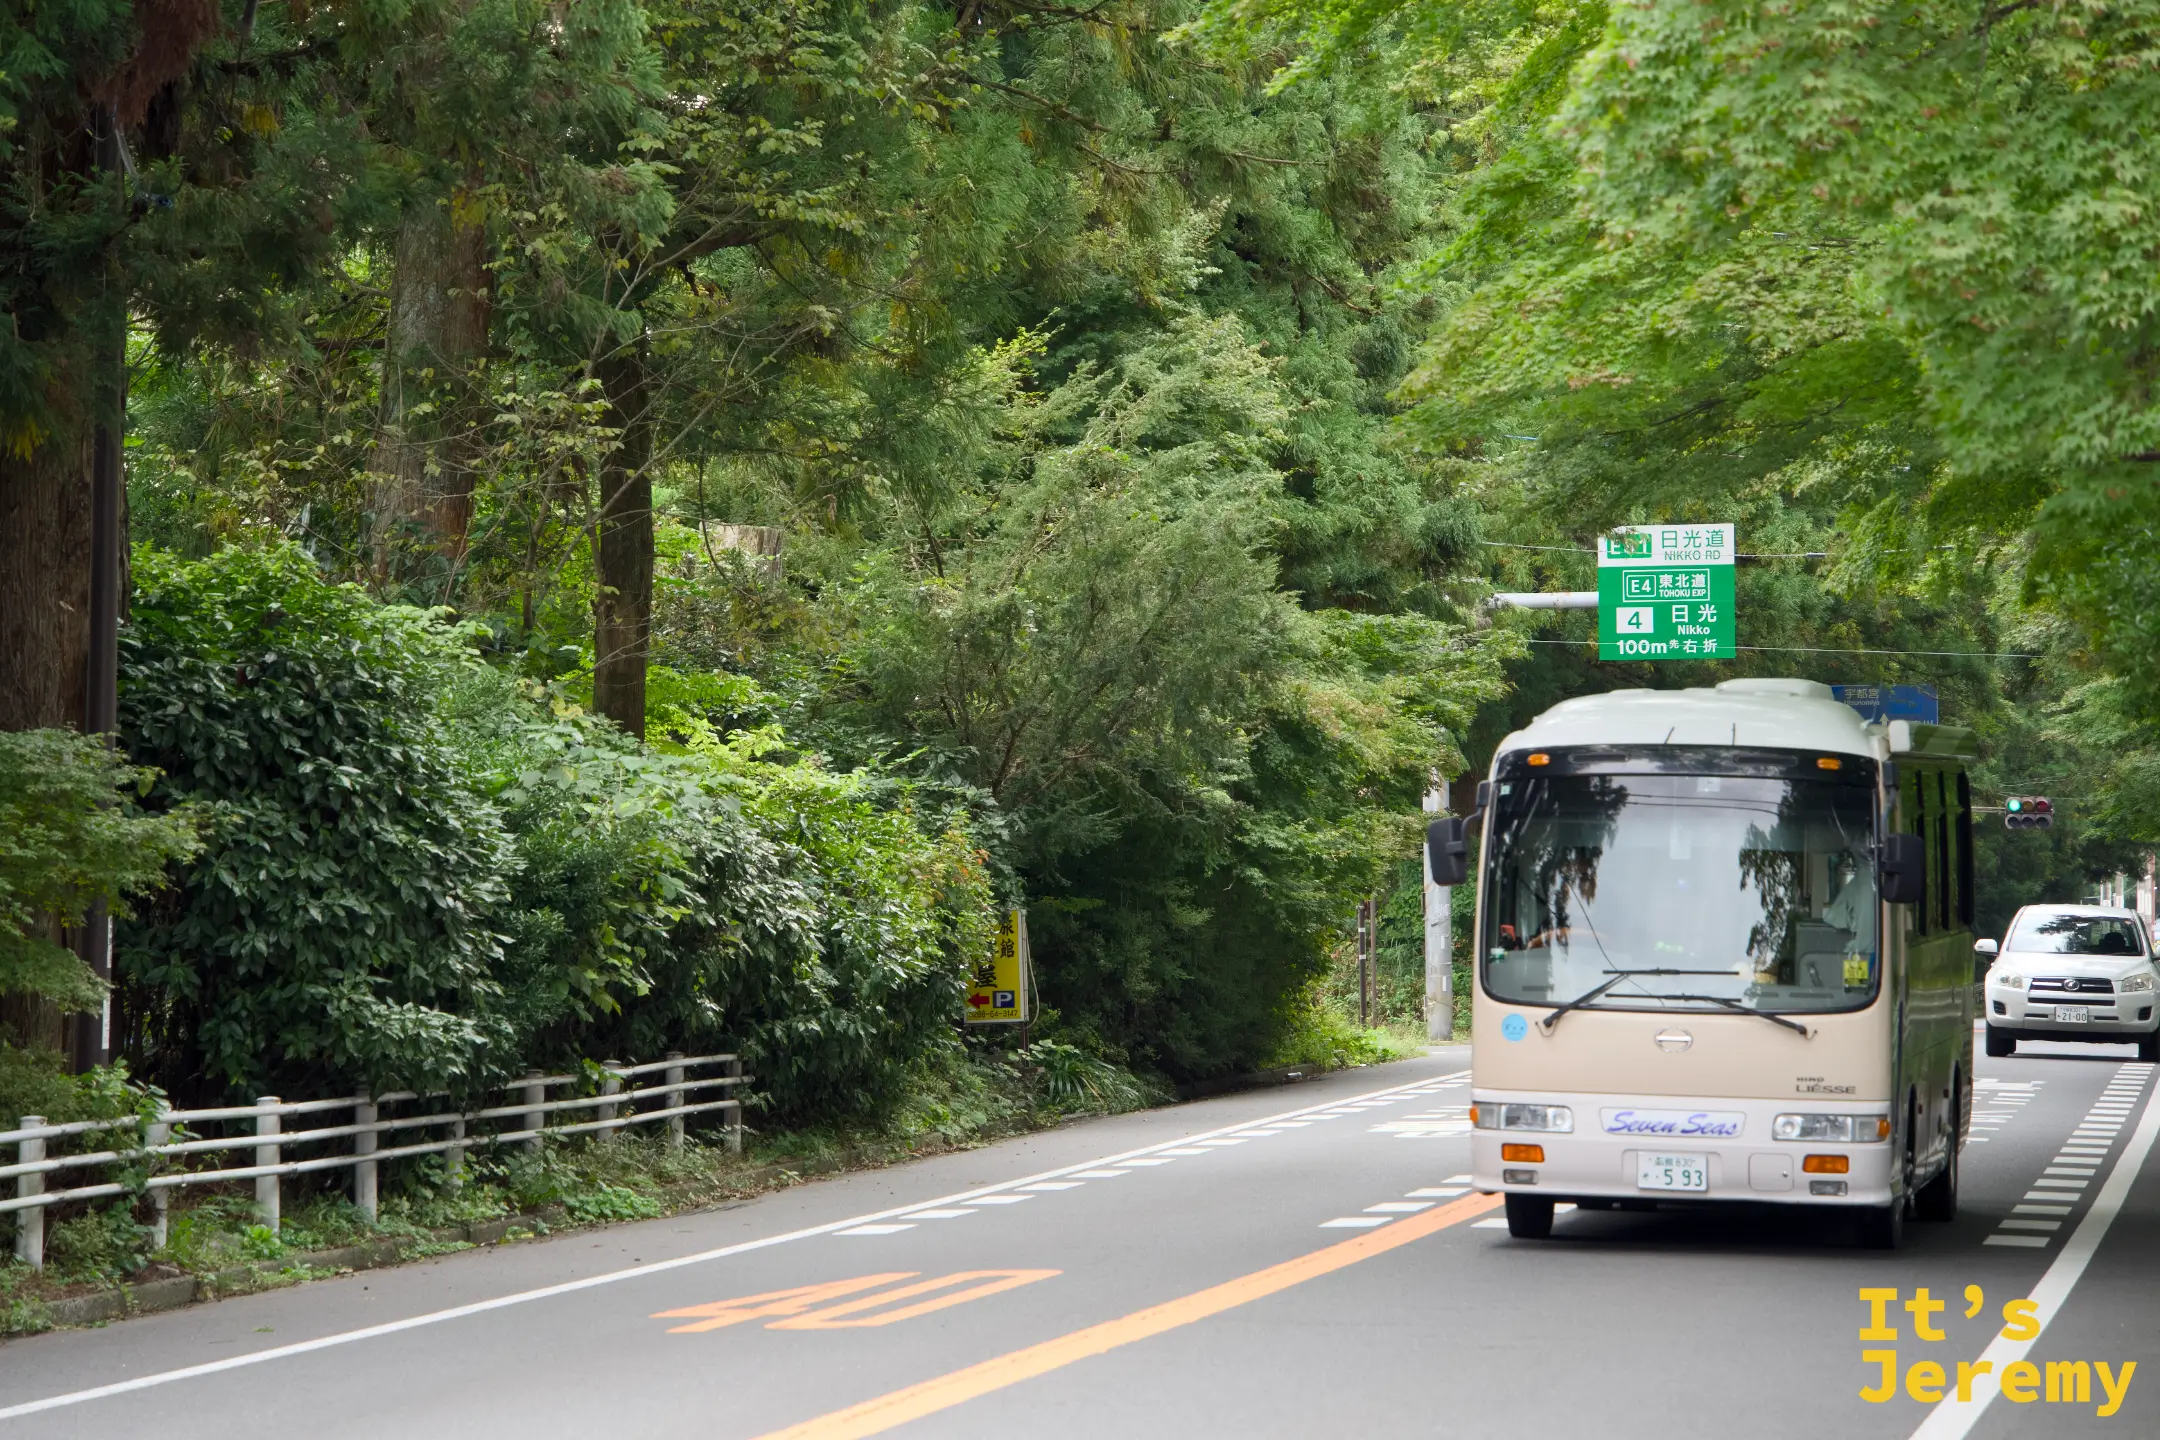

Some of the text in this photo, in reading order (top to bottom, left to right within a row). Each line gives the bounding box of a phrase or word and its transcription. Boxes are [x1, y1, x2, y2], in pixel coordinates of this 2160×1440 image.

[1610, 537, 1647, 555] E1
[1661, 529, 1725, 549] 日光道
[1664, 550, 1721, 561] NIKKO RD
[1631, 579, 1651, 593] E4
[1659, 573, 1706, 589] 東北道
[1659, 588, 1706, 598] TOHOKU EXP
[1627, 611, 1642, 630] 4
[1671, 604, 1717, 623] 日光
[1677, 625, 1710, 635] Nikko
[1844, 688, 1880, 699] 宇都宮
[996, 992, 1012, 1007] P
[2062, 1012, 2087, 1021] 21-00
[1607, 1111, 1737, 1135] Seven Seas
